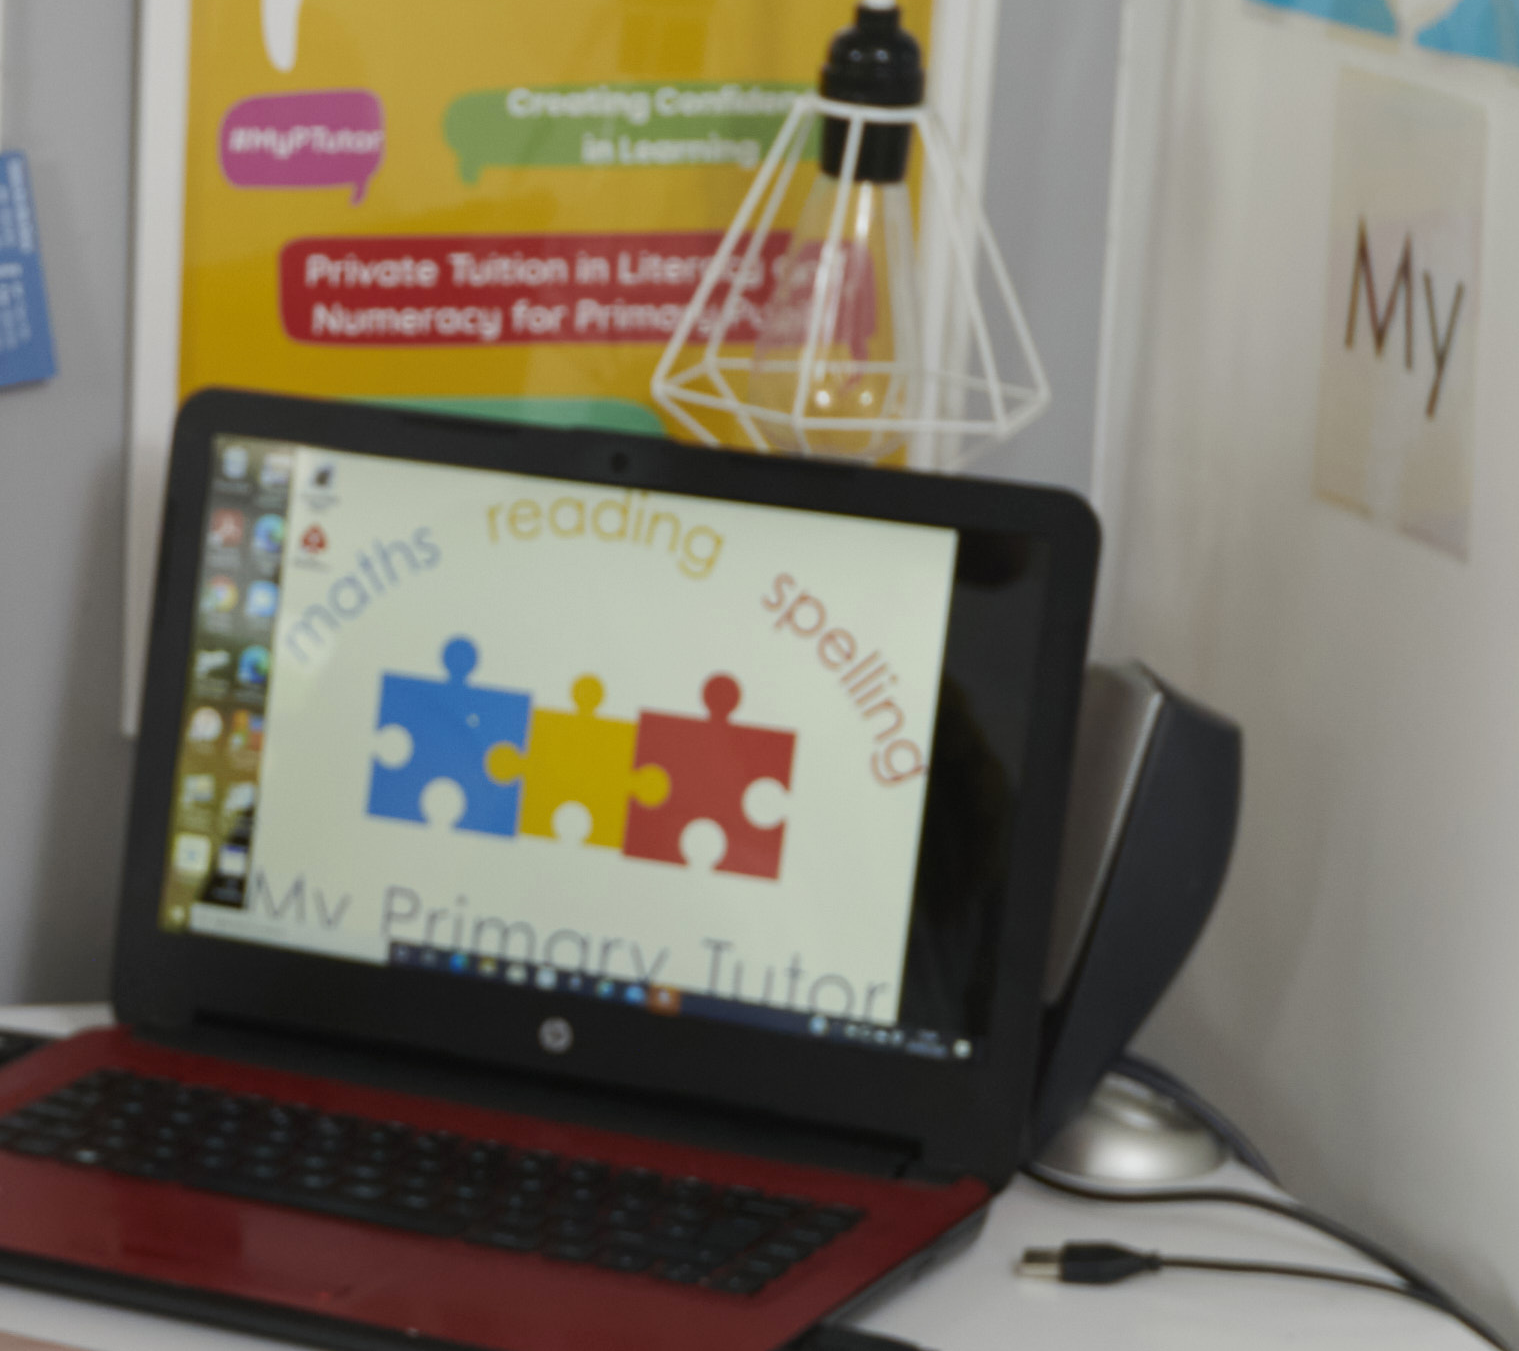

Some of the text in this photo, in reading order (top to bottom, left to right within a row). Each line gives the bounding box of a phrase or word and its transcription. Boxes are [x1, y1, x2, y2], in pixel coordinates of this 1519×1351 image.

[506, 83, 808, 124] Creating Confiden
[581, 131, 759, 169] in Learning
[305, 253, 439, 288] Private
[449, 251, 569, 287] Tuition
[575, 251, 610, 285] in
[312, 302, 503, 341] Numeracy
[511, 300, 569, 334] for
[1343, 212, 1465, 420] My
[484, 489, 724, 580] reading
[284, 526, 442, 667] maths
[760, 571, 927, 789] spelling
[700, 935, 891, 1019] Tutor
